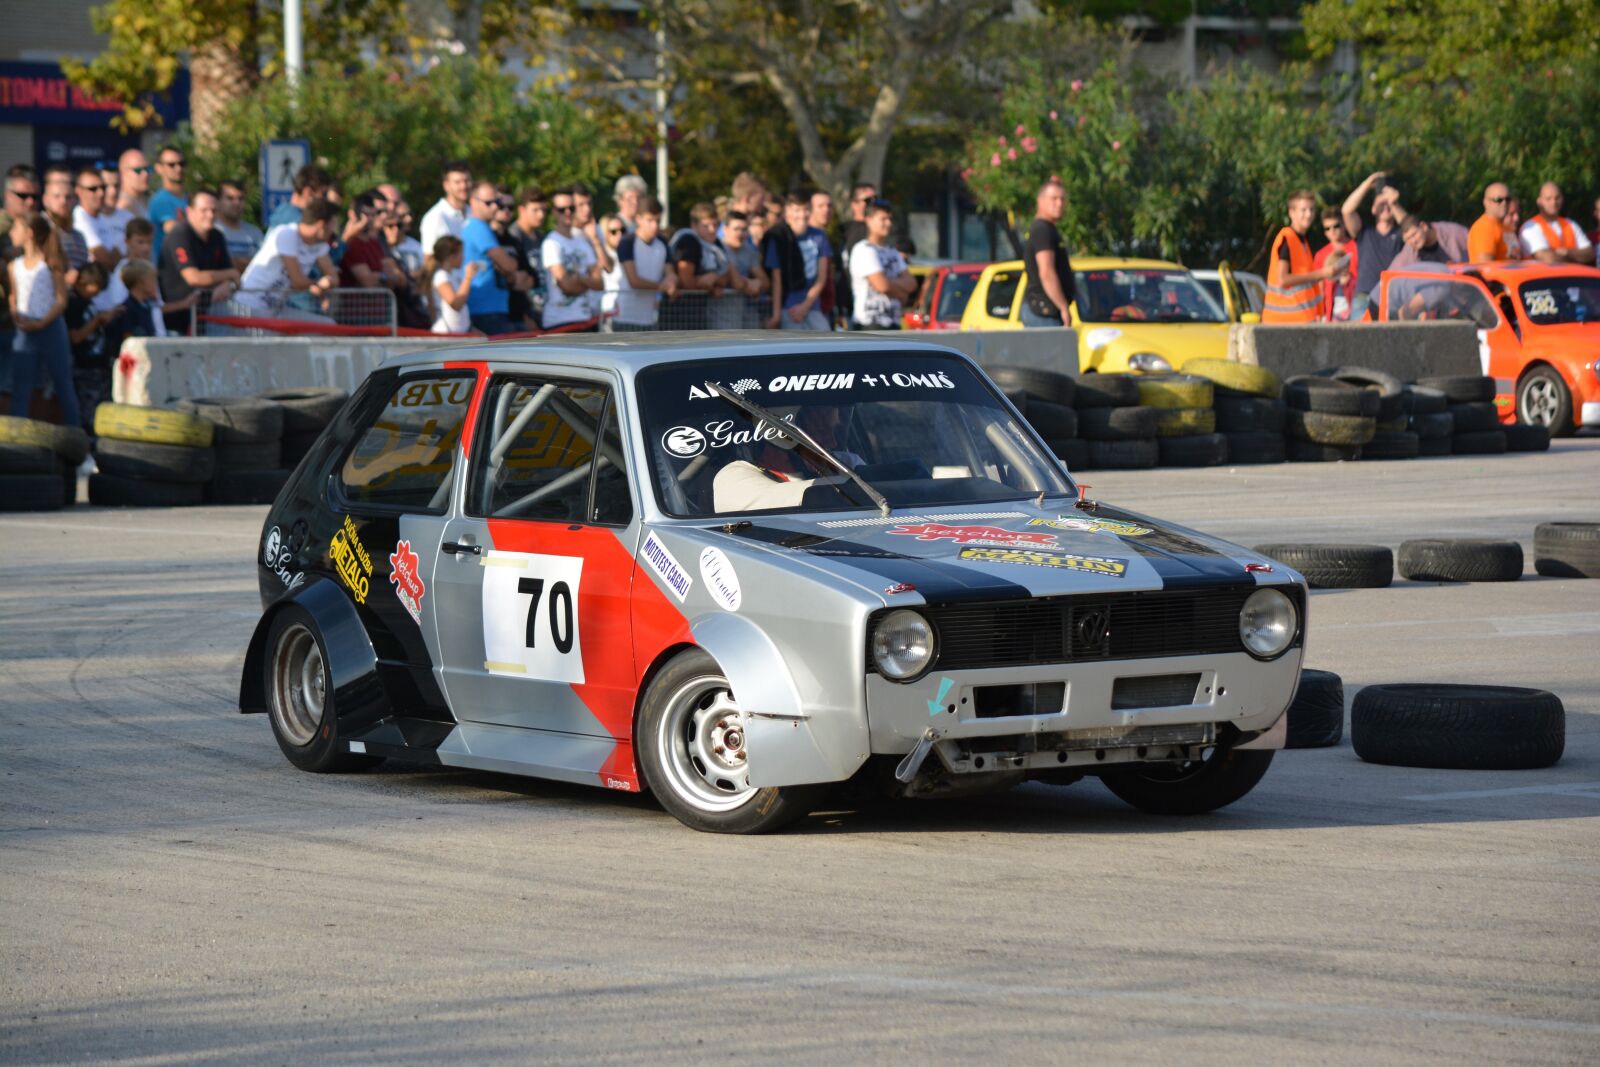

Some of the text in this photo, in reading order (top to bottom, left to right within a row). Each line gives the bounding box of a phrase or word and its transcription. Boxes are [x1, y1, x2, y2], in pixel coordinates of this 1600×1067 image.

[768, 373, 855, 393] ONEUM
[892, 370, 956, 389] OMIŠ
[344, 514, 374, 578] VUČNA SLUŽBA
[922, 526, 1033, 541] ketchup
[397, 551, 419, 597] ketchup
[643, 537, 673, 575] MOTOTEST
[517, 576, 574, 655] 70
